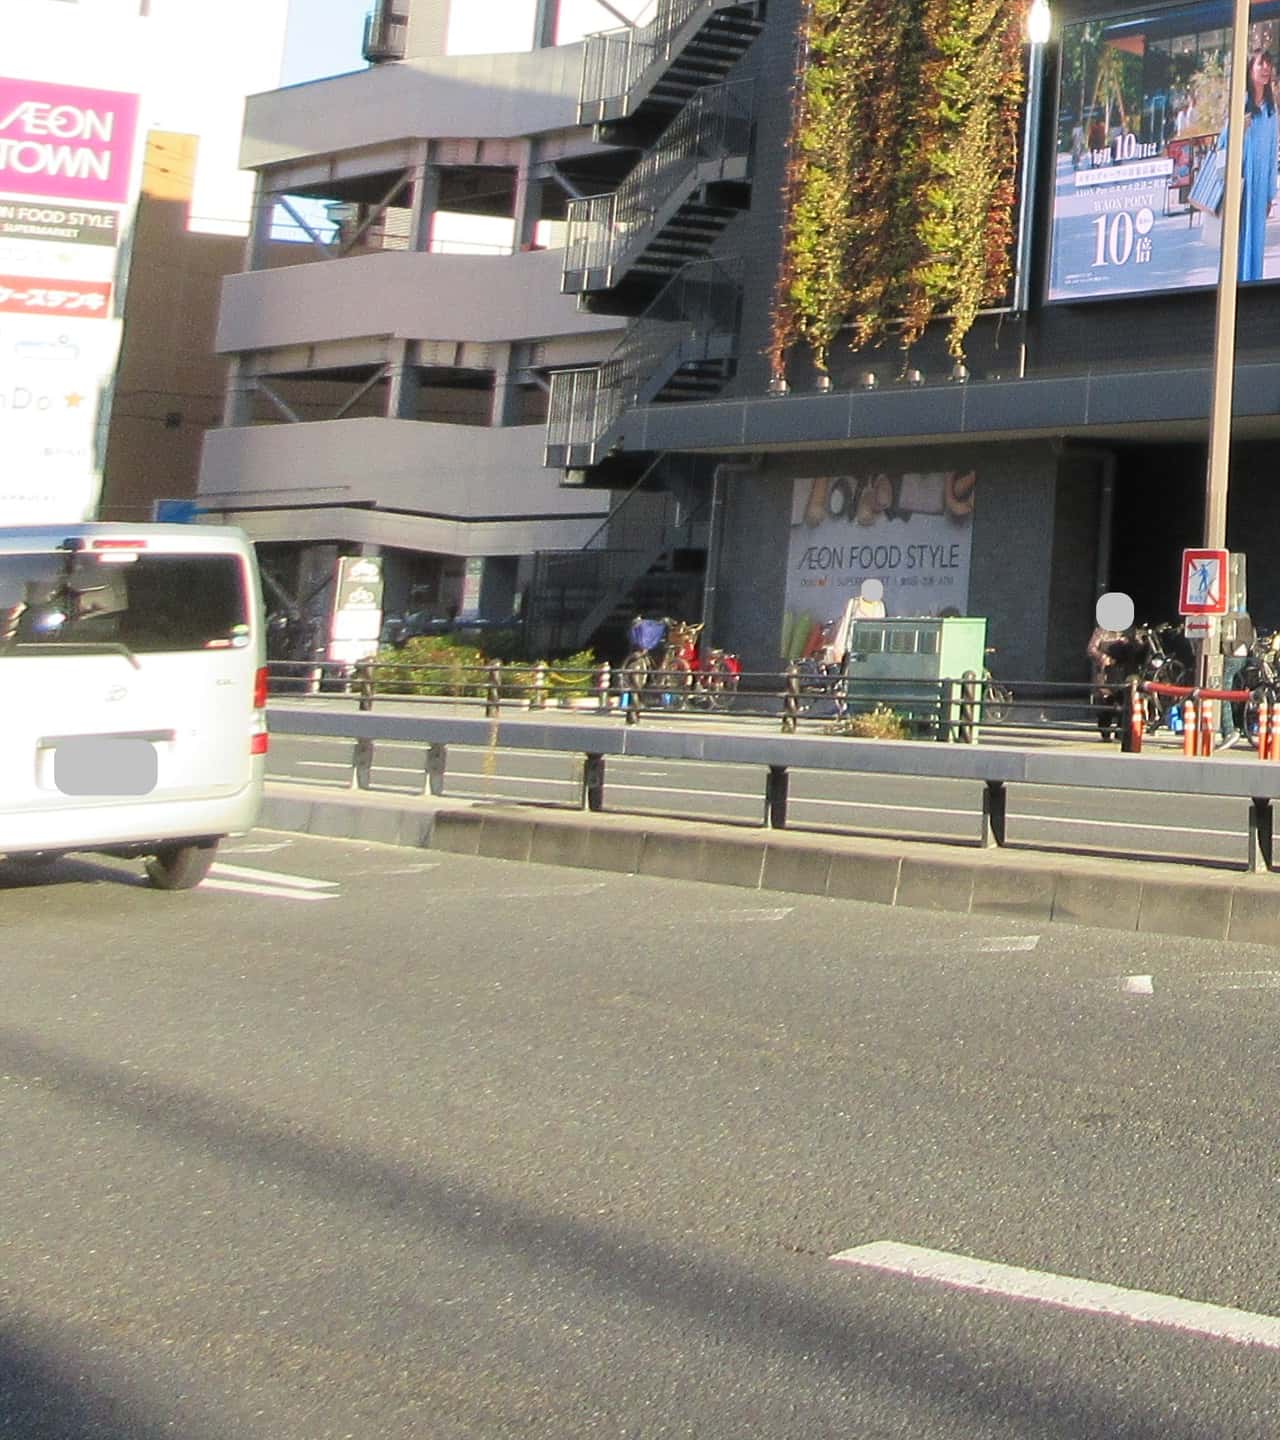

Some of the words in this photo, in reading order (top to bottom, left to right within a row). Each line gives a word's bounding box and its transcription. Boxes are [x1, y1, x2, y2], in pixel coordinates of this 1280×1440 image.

[17, 207, 66, 224] FOOD
[66, 212, 114, 229] STYLE
[851, 545, 902, 569] FOOD
[907, 544, 960, 569] STYLE
